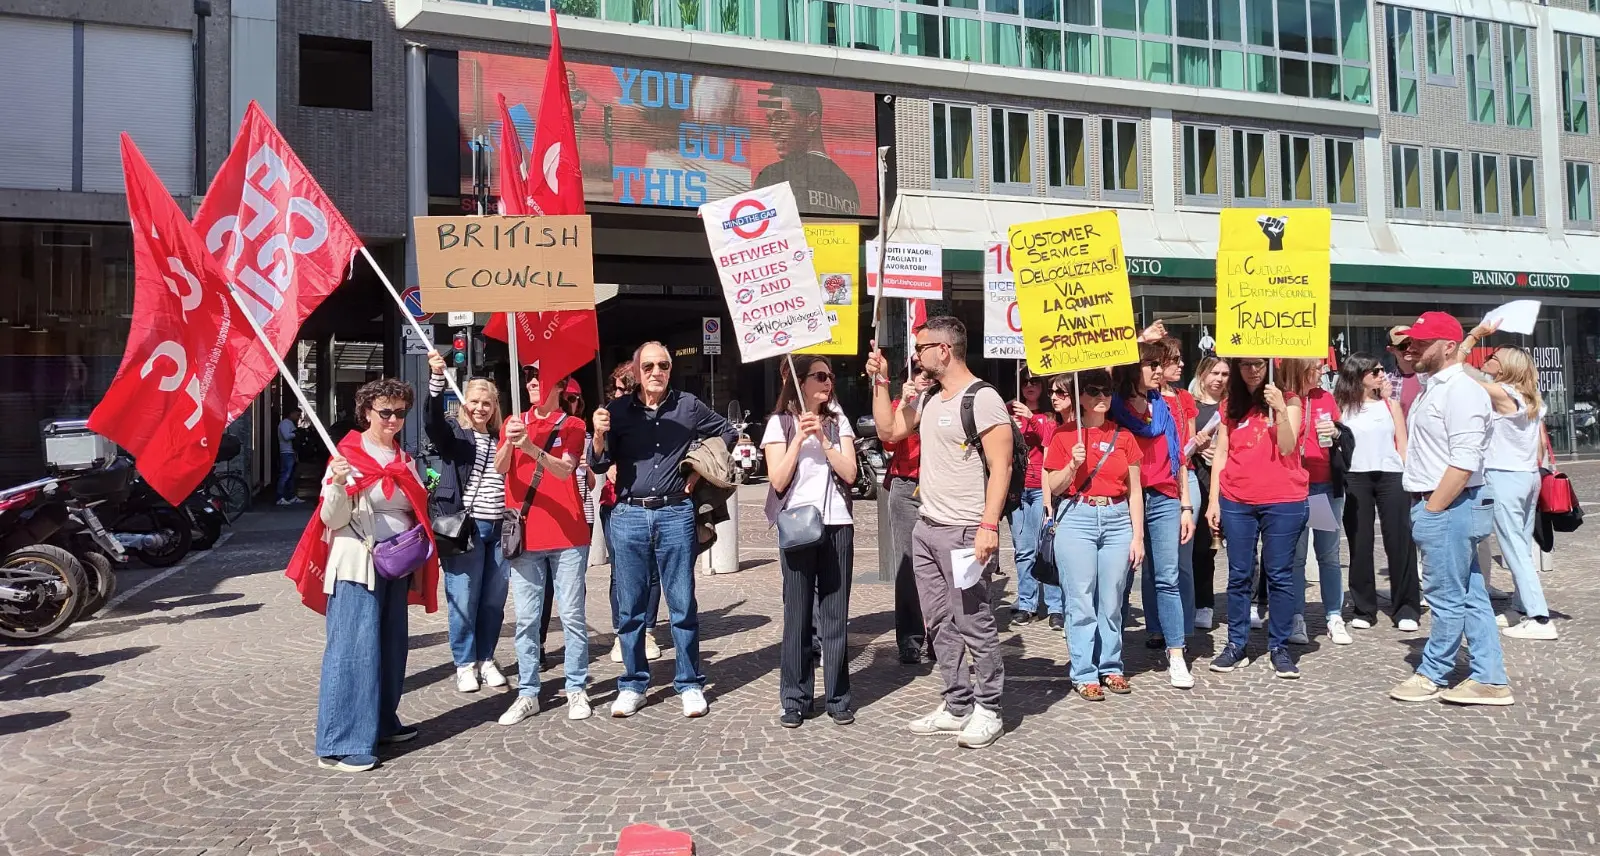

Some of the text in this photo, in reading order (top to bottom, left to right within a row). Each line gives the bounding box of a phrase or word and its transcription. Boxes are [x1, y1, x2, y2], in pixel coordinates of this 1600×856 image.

[611, 66, 692, 110] YOU
[678, 122, 751, 163] GOT
[613, 166, 707, 208] THIS
[461, 199, 499, 212] Stee
[807, 190, 858, 215] BELLINGH
[723, 209, 776, 229] MIND THE GAP
[437, 220, 578, 251] BRITISH
[1011, 224, 1101, 250] CUSTOMER
[720, 239, 789, 267] BETWEEN
[875, 246, 901, 254] TDITI
[1027, 244, 1089, 263] SERVICE
[445, 265, 578, 289] COUNCIL
[732, 261, 788, 284] VALUES
[1268, 275, 1309, 285] UNISCE
[1472, 271, 1570, 288] PANINO GIUSTO
[760, 278, 791, 295] AND
[1054, 282, 1085, 297] VIA
[741, 296, 806, 323] ACTIONS
[1043, 298, 1063, 313] LA
[1230, 301, 1317, 329] TRADISCE!
[517, 312, 535, 342] Milano
[1057, 313, 1107, 332] AVANTI
[1040, 326, 1135, 352] SFRUTTAMENTO
[1533, 347, 1563, 368] GUSTO.
